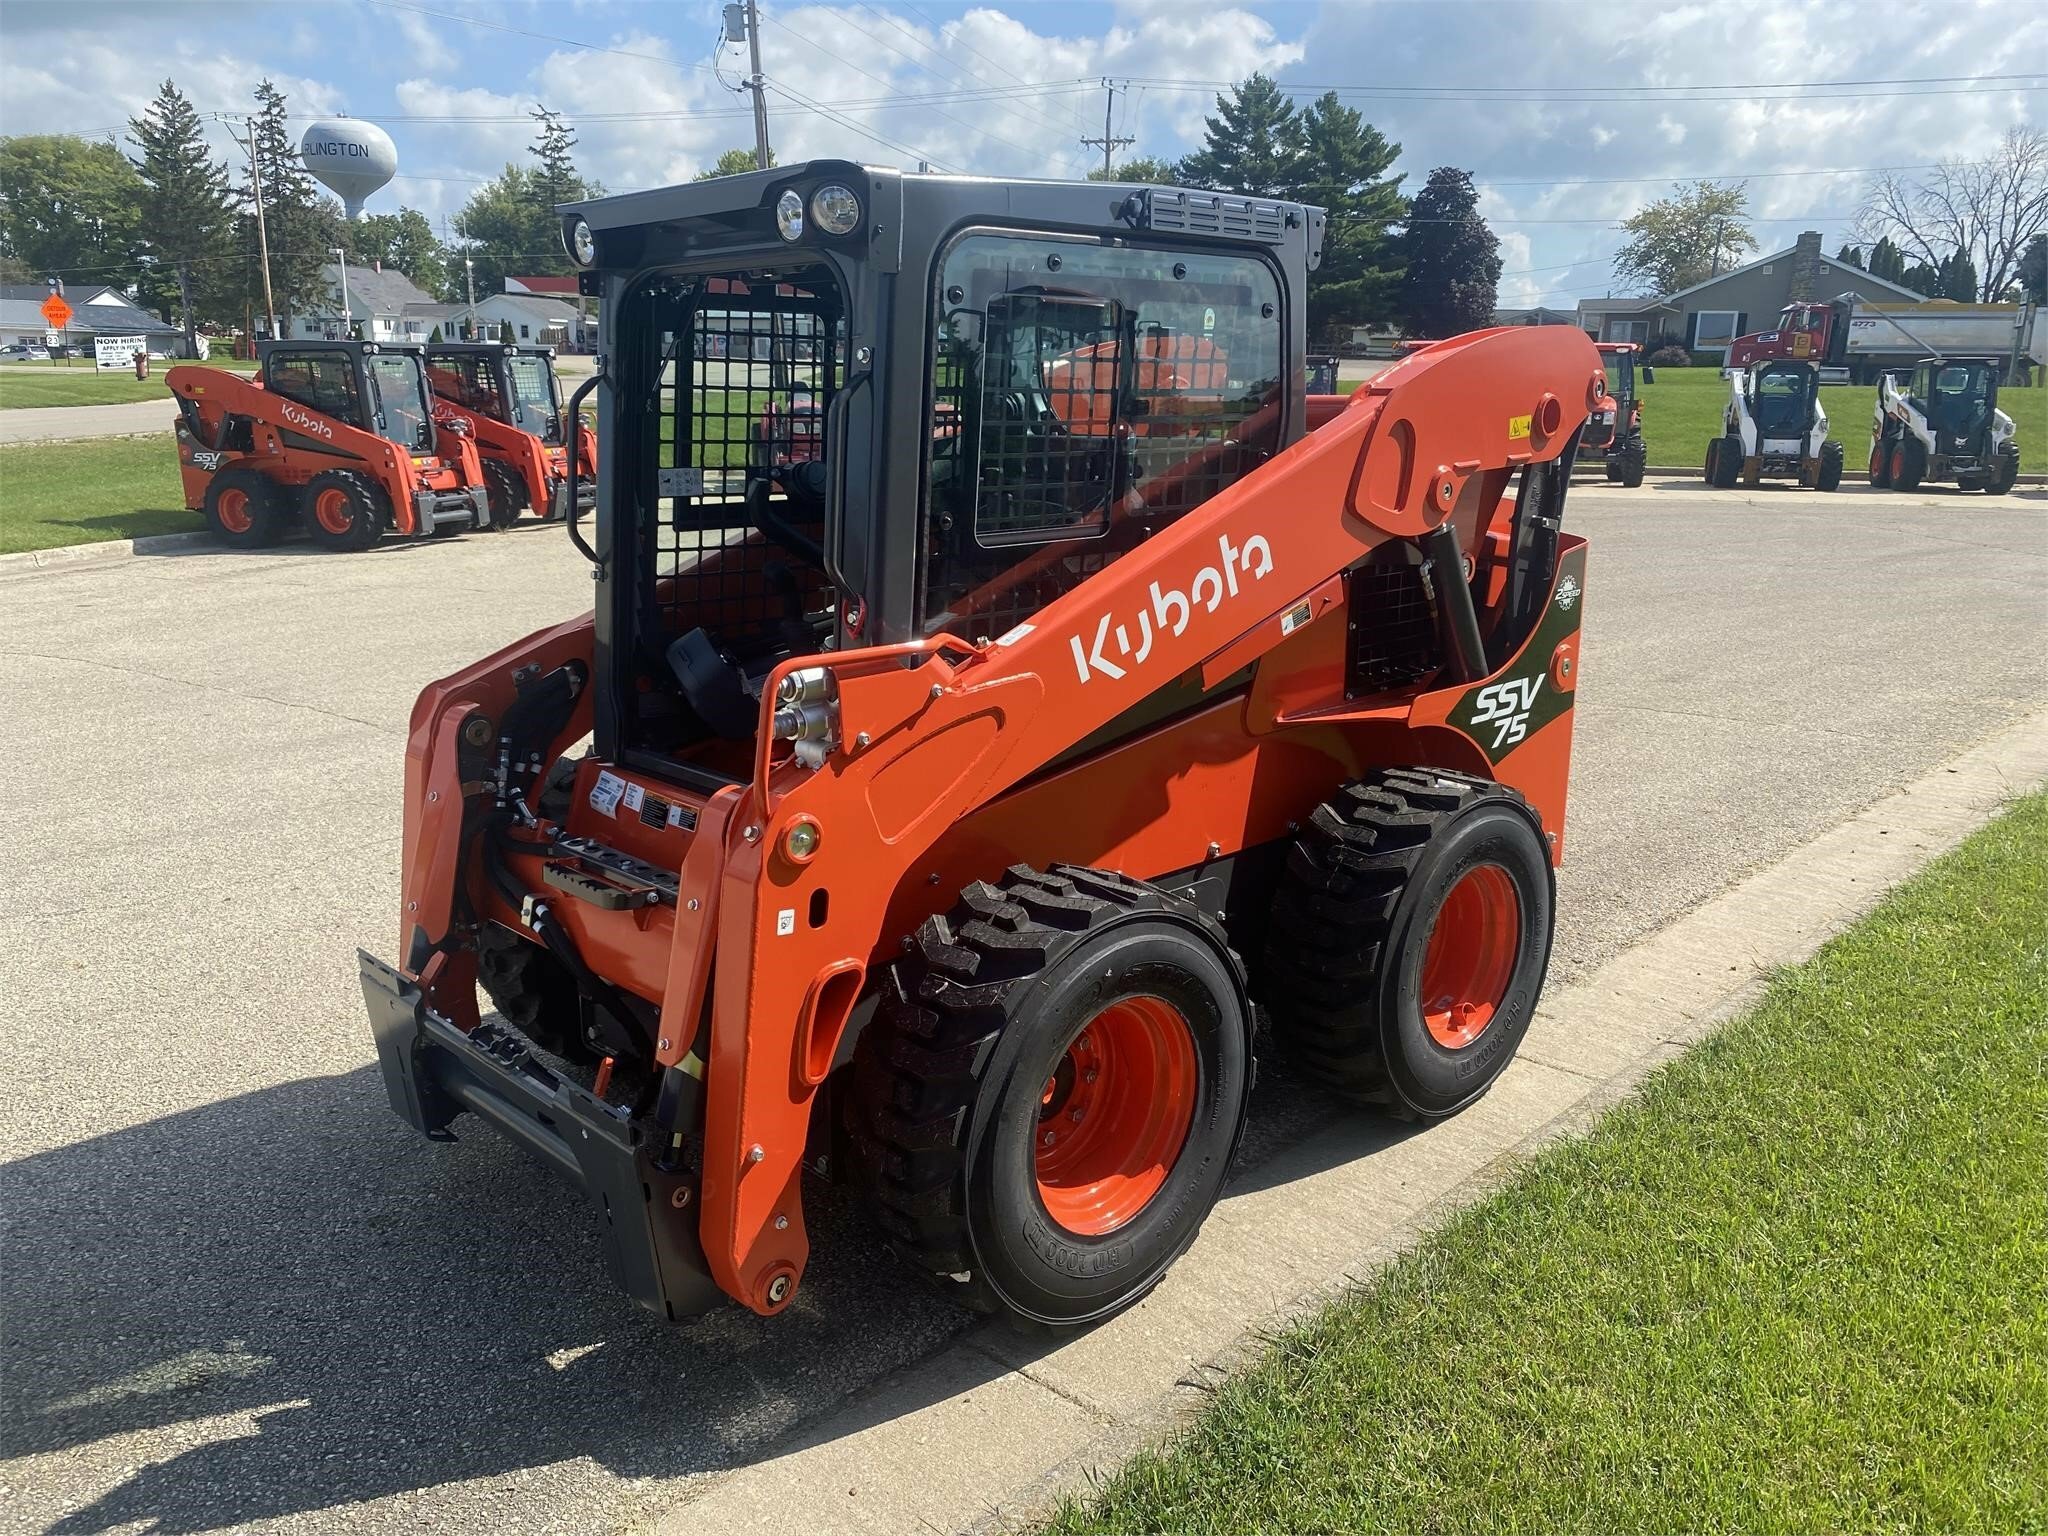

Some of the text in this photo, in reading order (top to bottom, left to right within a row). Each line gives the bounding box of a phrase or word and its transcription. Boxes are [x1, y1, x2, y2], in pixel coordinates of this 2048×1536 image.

[121, 336, 146, 344] HIRING
[281, 403, 333, 439] Kubota
[193, 452, 221, 462] SSV
[202, 462, 217, 470] 75
[1069, 533, 1274, 685] Kubota
[1470, 672, 1546, 725] SSV
[1491, 711, 1530, 749] 75
